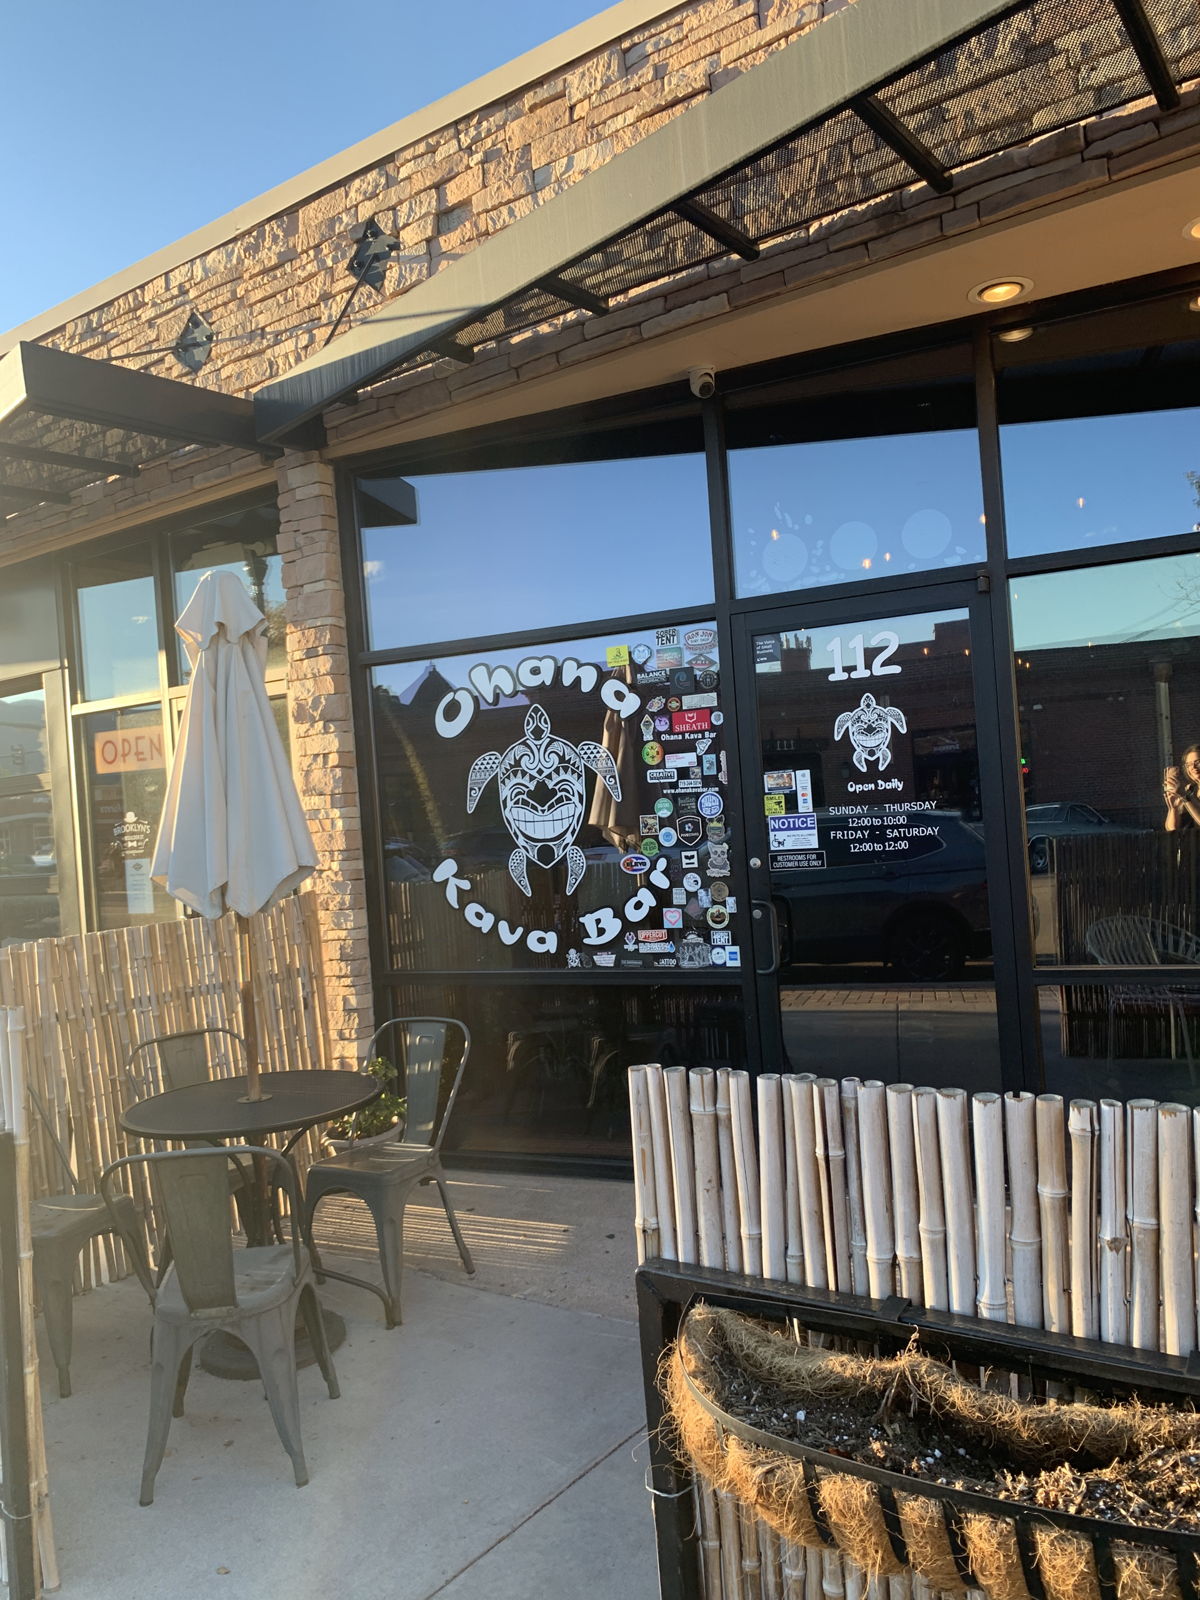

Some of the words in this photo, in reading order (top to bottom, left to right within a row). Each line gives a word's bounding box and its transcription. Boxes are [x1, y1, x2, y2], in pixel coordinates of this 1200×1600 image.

[656, 634, 676, 646] TENT
[826, 631, 902, 682] 112
[637, 670, 666, 679] BALANCE
[435, 658, 640, 738] Ohana
[675, 722, 708, 732] SHEATH
[101, 734, 162, 765] OPEN
[847, 781, 875, 794] Open
[877, 778, 904, 791] Daily
[829, 805, 868, 815] SUNDAY
[884, 801, 937, 812] THURSDAY
[771, 817, 815, 829] NOTICE
[848, 817, 871, 827] 12:00
[872, 817, 882, 826] to
[883, 816, 907, 825] 10:00
[113, 824, 151, 837] BROOKLYN'S
[830, 830, 870, 839] FRIDAY
[886, 826, 939, 838] SATURDAY
[850, 843, 873, 853] 12:00
[874, 842, 883, 851] to
[885, 841, 909, 850] 12:00
[433, 859, 557, 952] Kava
[580, 857, 670, 946] Bar
